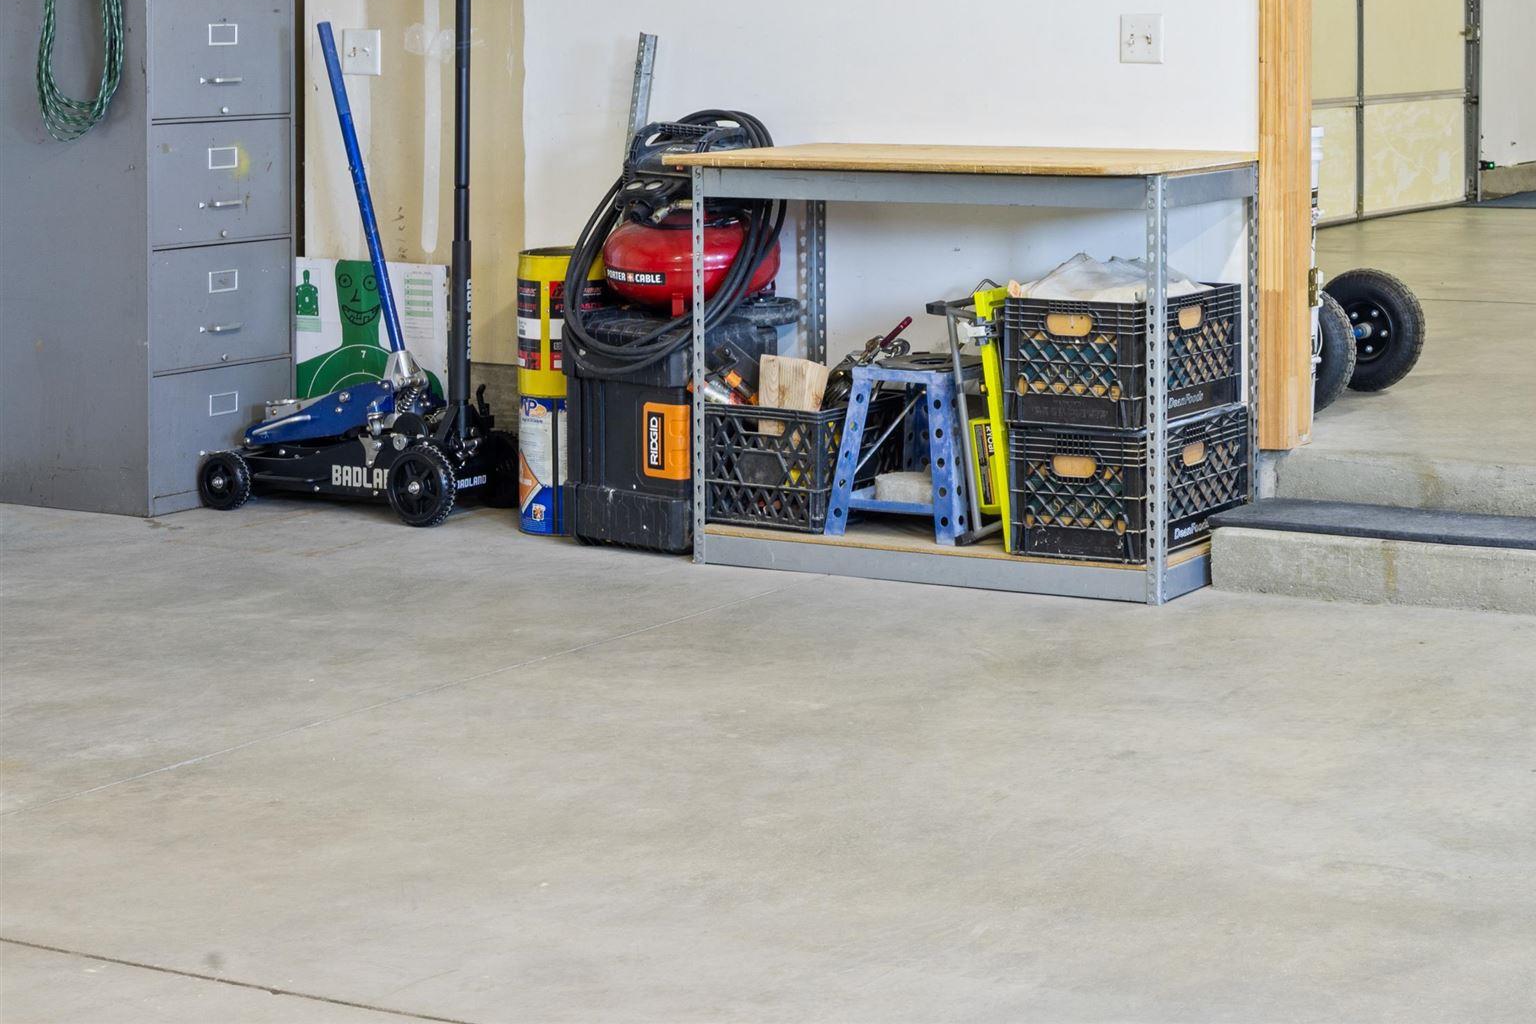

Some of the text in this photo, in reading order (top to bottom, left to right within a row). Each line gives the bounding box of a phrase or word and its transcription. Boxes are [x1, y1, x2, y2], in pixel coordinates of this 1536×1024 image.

[606, 269, 662, 284] PORTER CABLE
[360, 349, 367, 359] 7
[649, 415, 659, 466] RIDGID
[985, 426, 995, 453] RYOBI
[331, 464, 390, 489] BADLA
